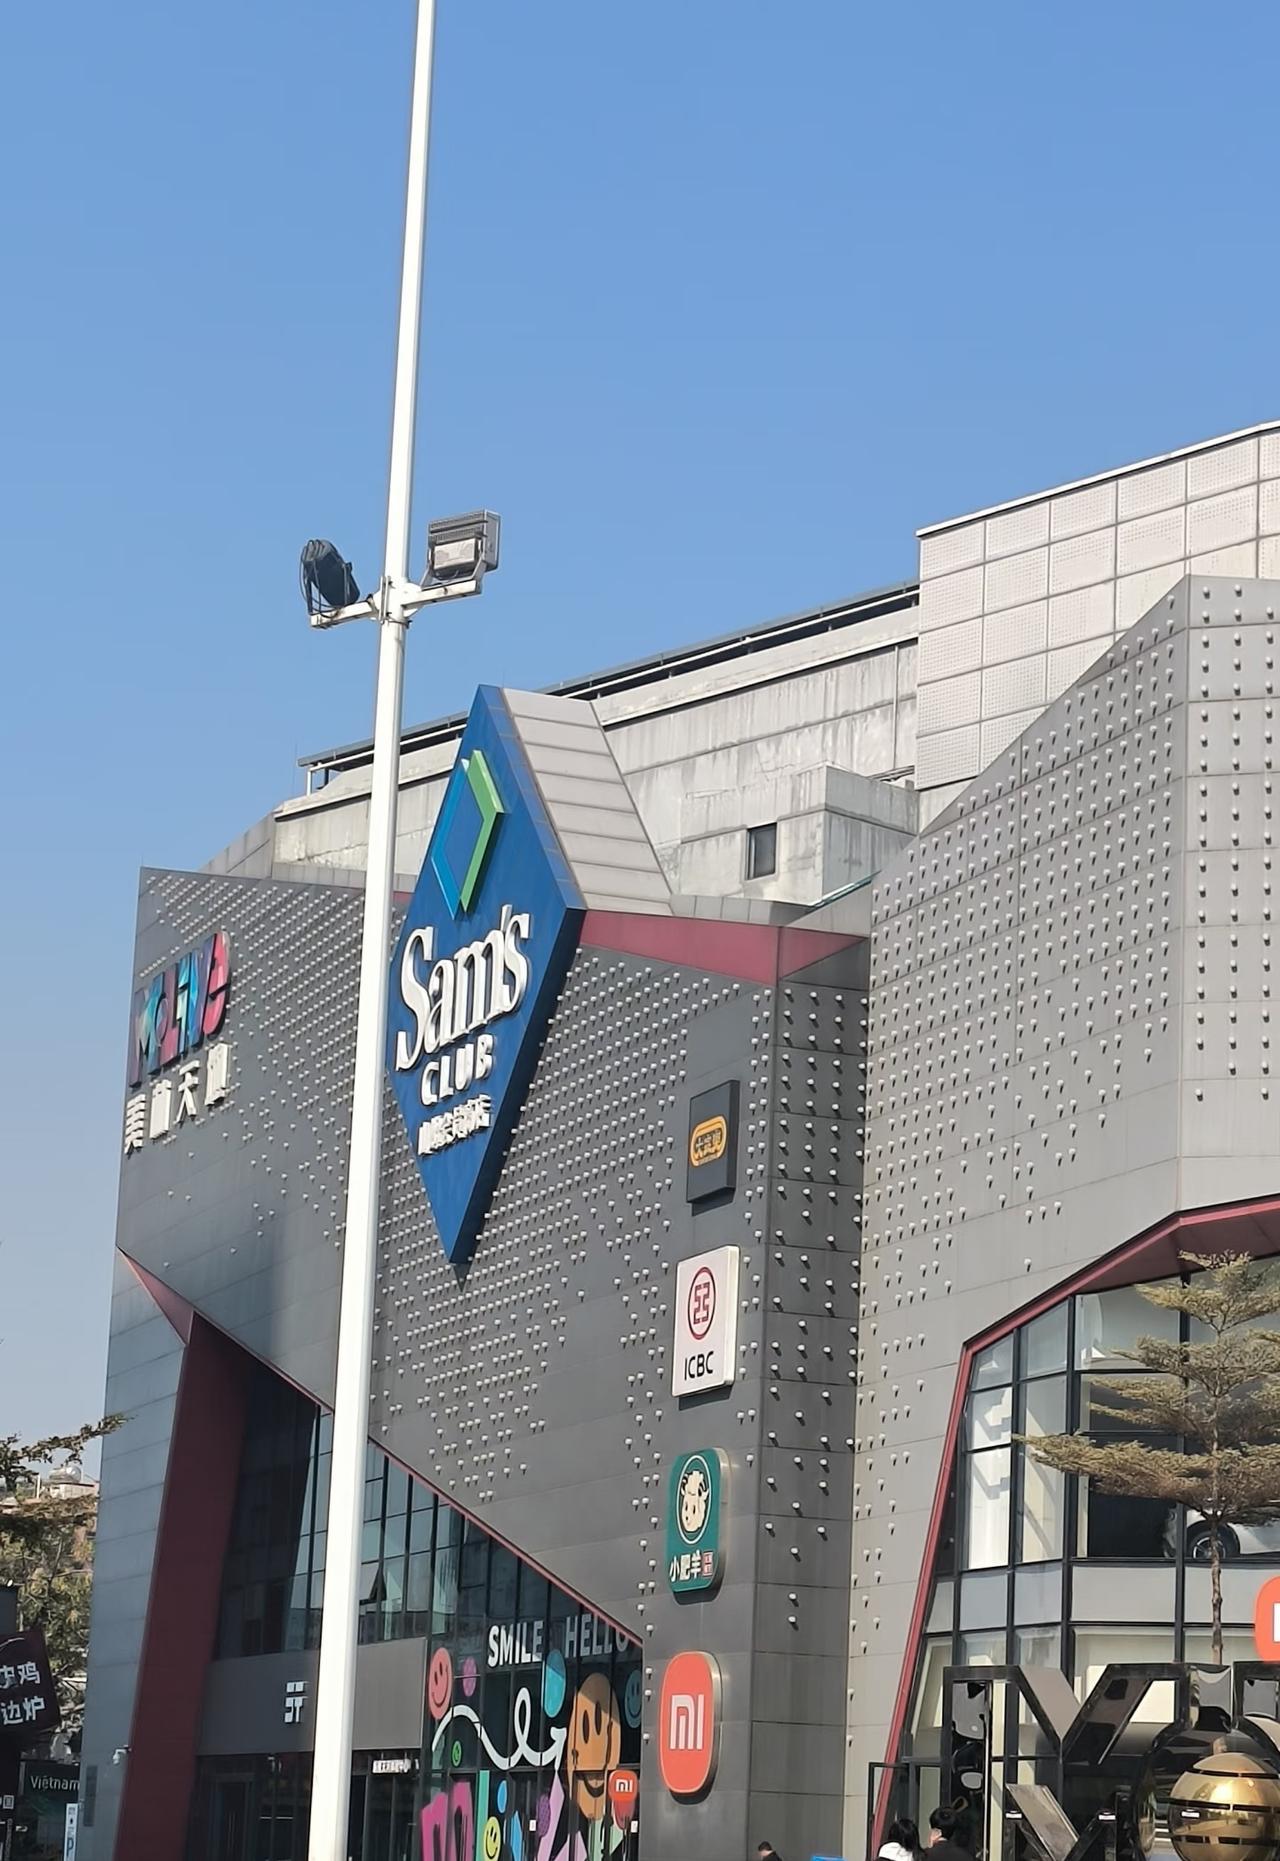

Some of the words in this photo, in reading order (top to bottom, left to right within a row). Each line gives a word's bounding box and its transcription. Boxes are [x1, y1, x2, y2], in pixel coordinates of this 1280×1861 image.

[396, 904, 530, 1072] Sam's
[421, 1034, 494, 1106] CLUB
[684, 1351, 714, 1381] ICBC
[669, 1549, 702, 1582] 小肥羊
[487, 1620, 544, 1668] SMILE
[1, 1696, 45, 1725] 边炉
